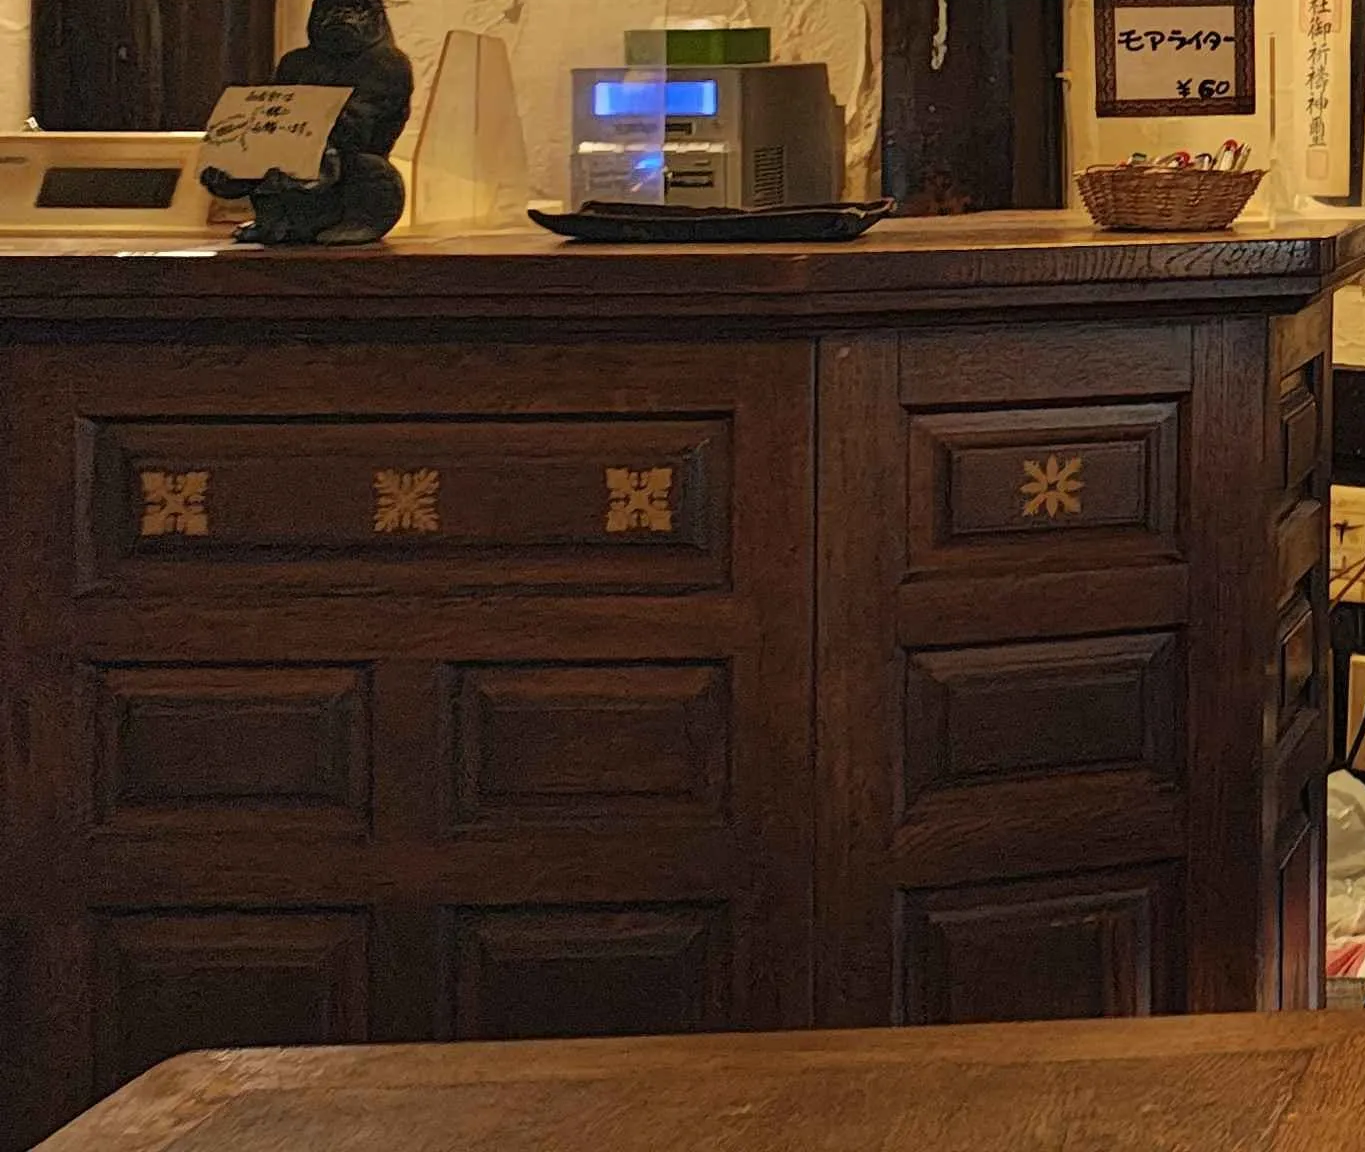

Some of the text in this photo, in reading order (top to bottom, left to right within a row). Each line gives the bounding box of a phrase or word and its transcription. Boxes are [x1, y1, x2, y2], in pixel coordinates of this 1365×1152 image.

[1117, 29, 1236, 52] モアライター
